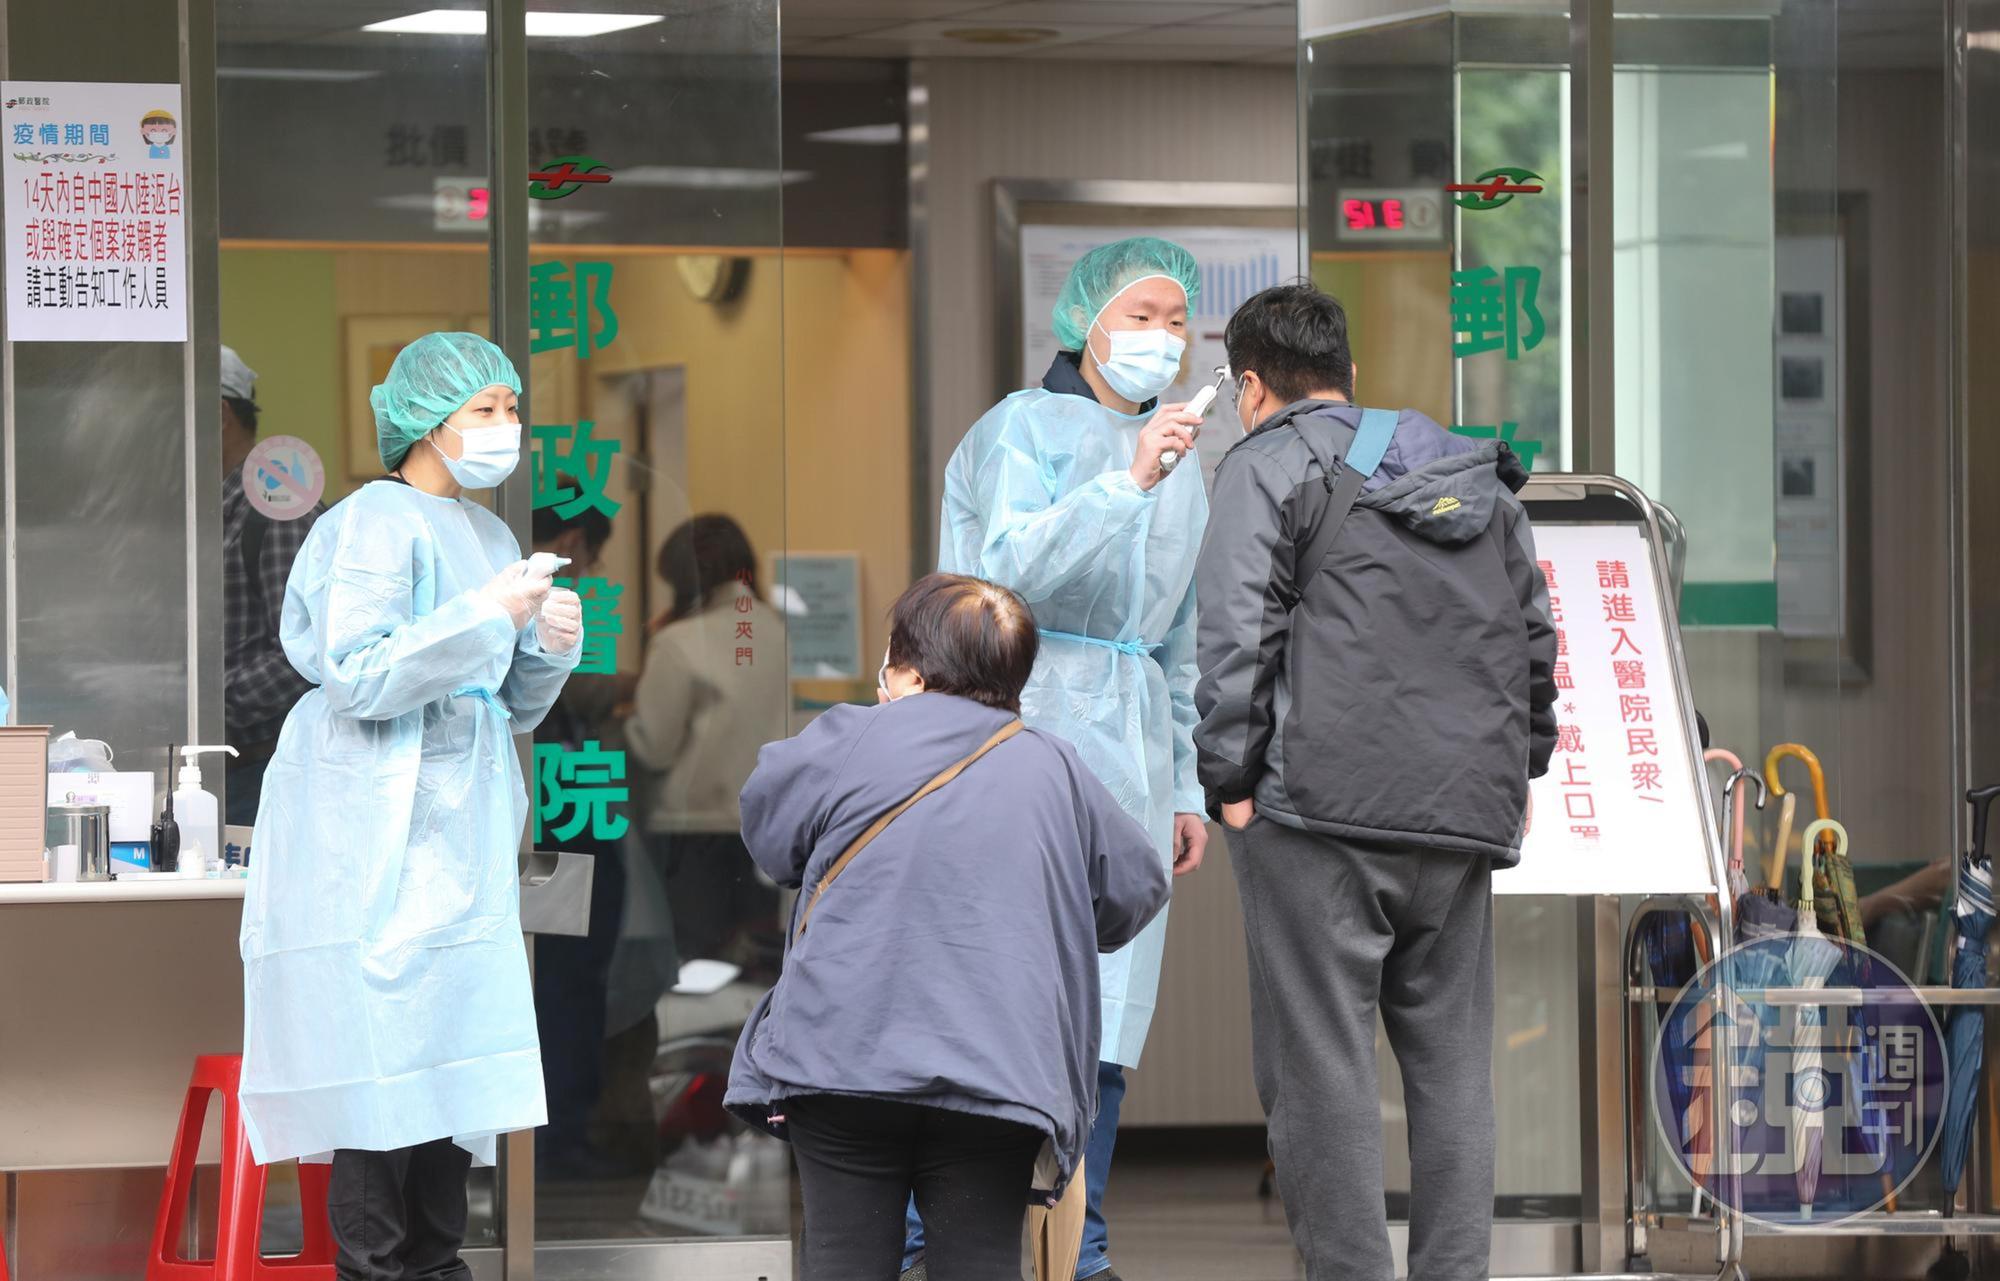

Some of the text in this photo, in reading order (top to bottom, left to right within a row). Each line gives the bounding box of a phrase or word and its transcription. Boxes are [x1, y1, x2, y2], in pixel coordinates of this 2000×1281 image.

[14, 123, 110, 146] 疫情期間
[24, 171, 181, 216] 14天內自中國大陸返台
[25, 217, 167, 263] 或與確定個案接觸者
[26, 265, 169, 310] 請主動告知工作人員
[133, 847, 146, 860] M
